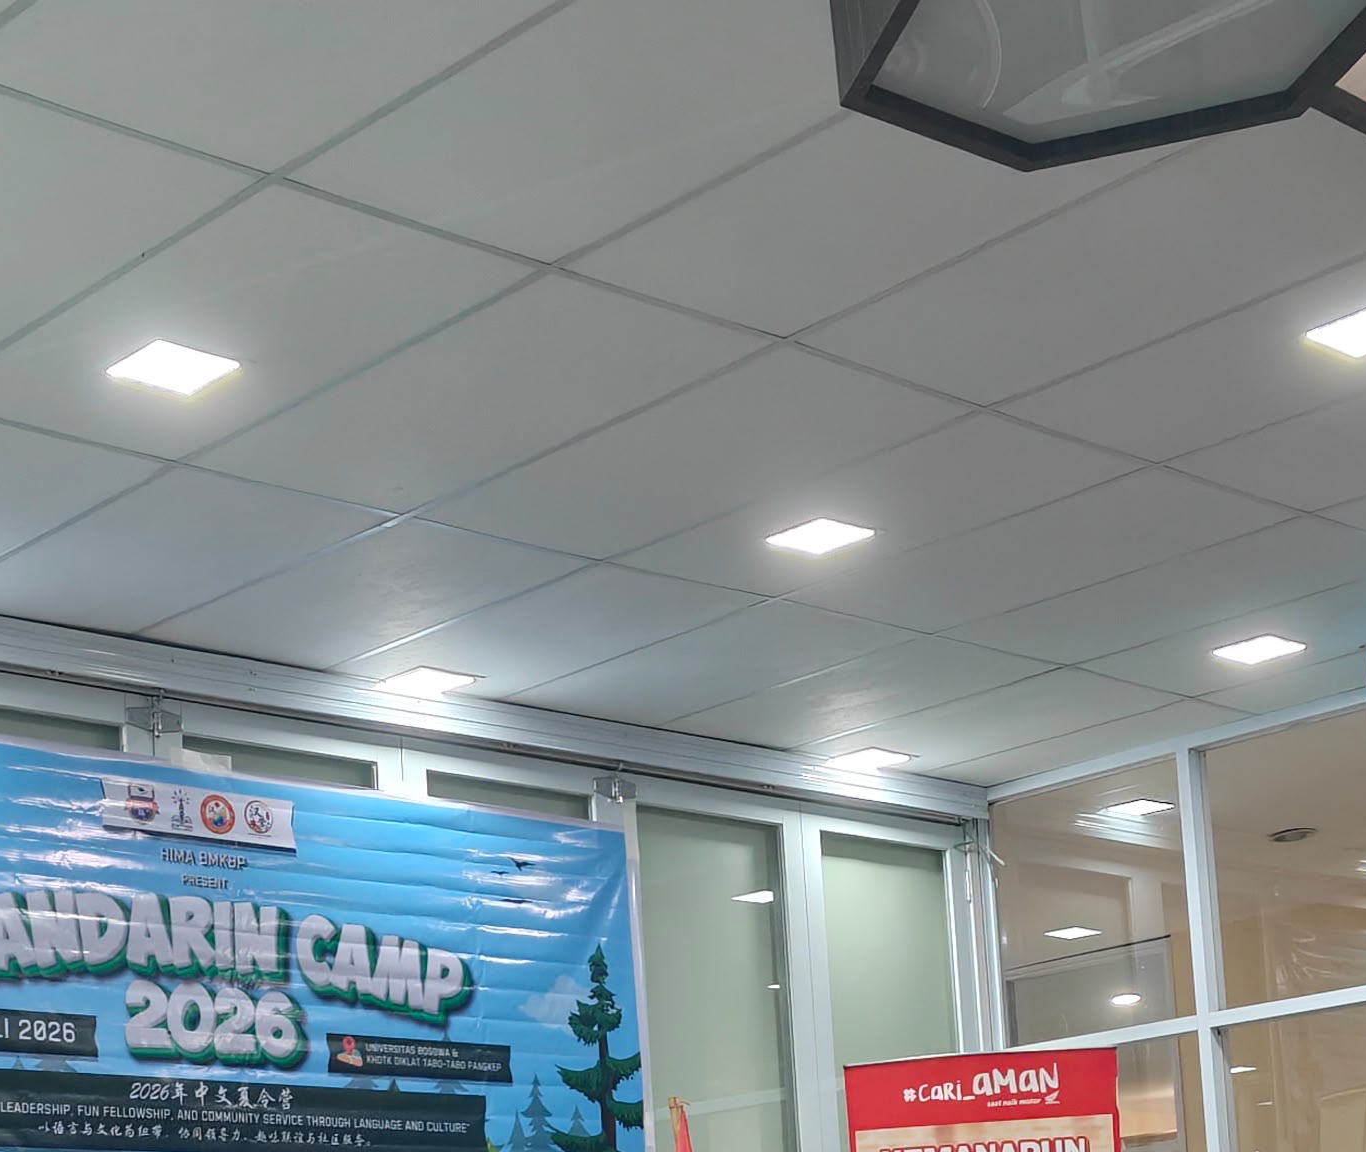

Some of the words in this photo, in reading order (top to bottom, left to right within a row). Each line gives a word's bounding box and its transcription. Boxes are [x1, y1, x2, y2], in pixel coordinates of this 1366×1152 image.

[161, 848, 195, 865] HIMA
[181, 874, 228, 890] PRESENT
[297, 913, 468, 1016] CAMP
[125, 979, 303, 1060] 2026
[18, 1019, 76, 1043] 2026
[365, 1043, 416, 1055] UNIVERSITAS
[394, 1057, 421, 1067] DIKLAT
[422, 1059, 466, 1070] TABO-TABO
[467, 1062, 502, 1072] PANGKEP
[0, 1101, 75, 1117] LEADERSHIP,
[77, 1104, 99, 1117] FUN
[177, 1109, 198, 1121] AND
[201, 1109, 260, 1125] COMMUNITY
[263, 1113, 303, 1126] SERVICE
[306, 1115, 351, 1128] THROUGH
[354, 1118, 403, 1131] LANGUAGE
[405, 1120, 424, 1132] AND
